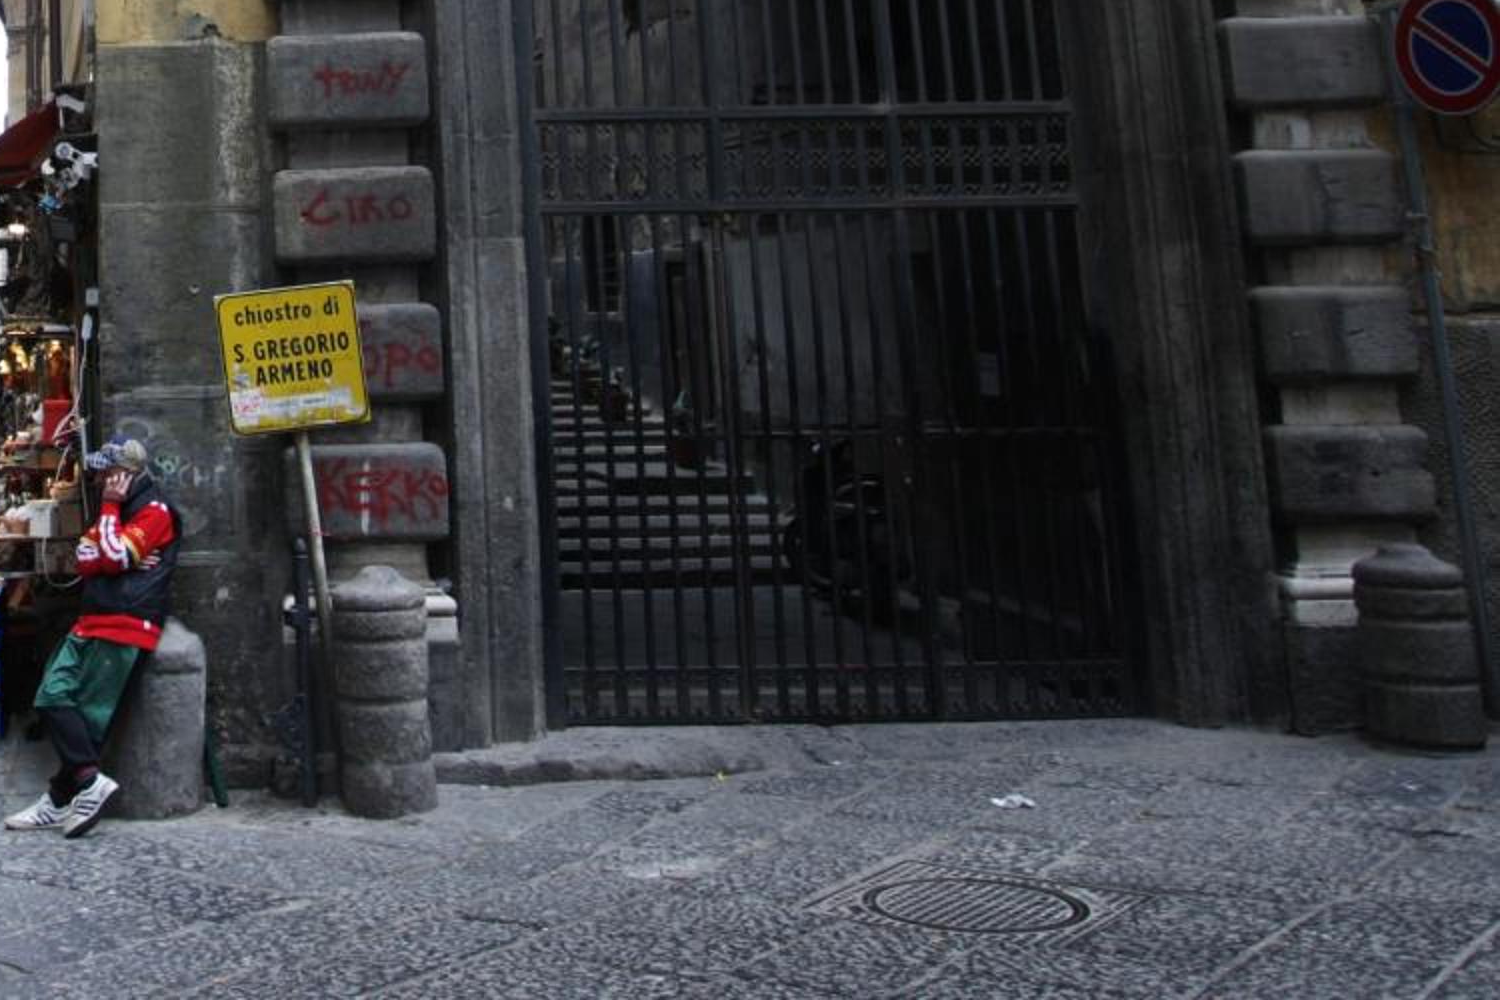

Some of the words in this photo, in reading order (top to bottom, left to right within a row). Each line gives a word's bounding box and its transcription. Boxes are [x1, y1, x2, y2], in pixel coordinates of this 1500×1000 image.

[234, 302, 312, 326] chiostro
[323, 295, 340, 315] di
[253, 331, 350, 361] GREGORIO
[255, 358, 333, 387] ARMENO
